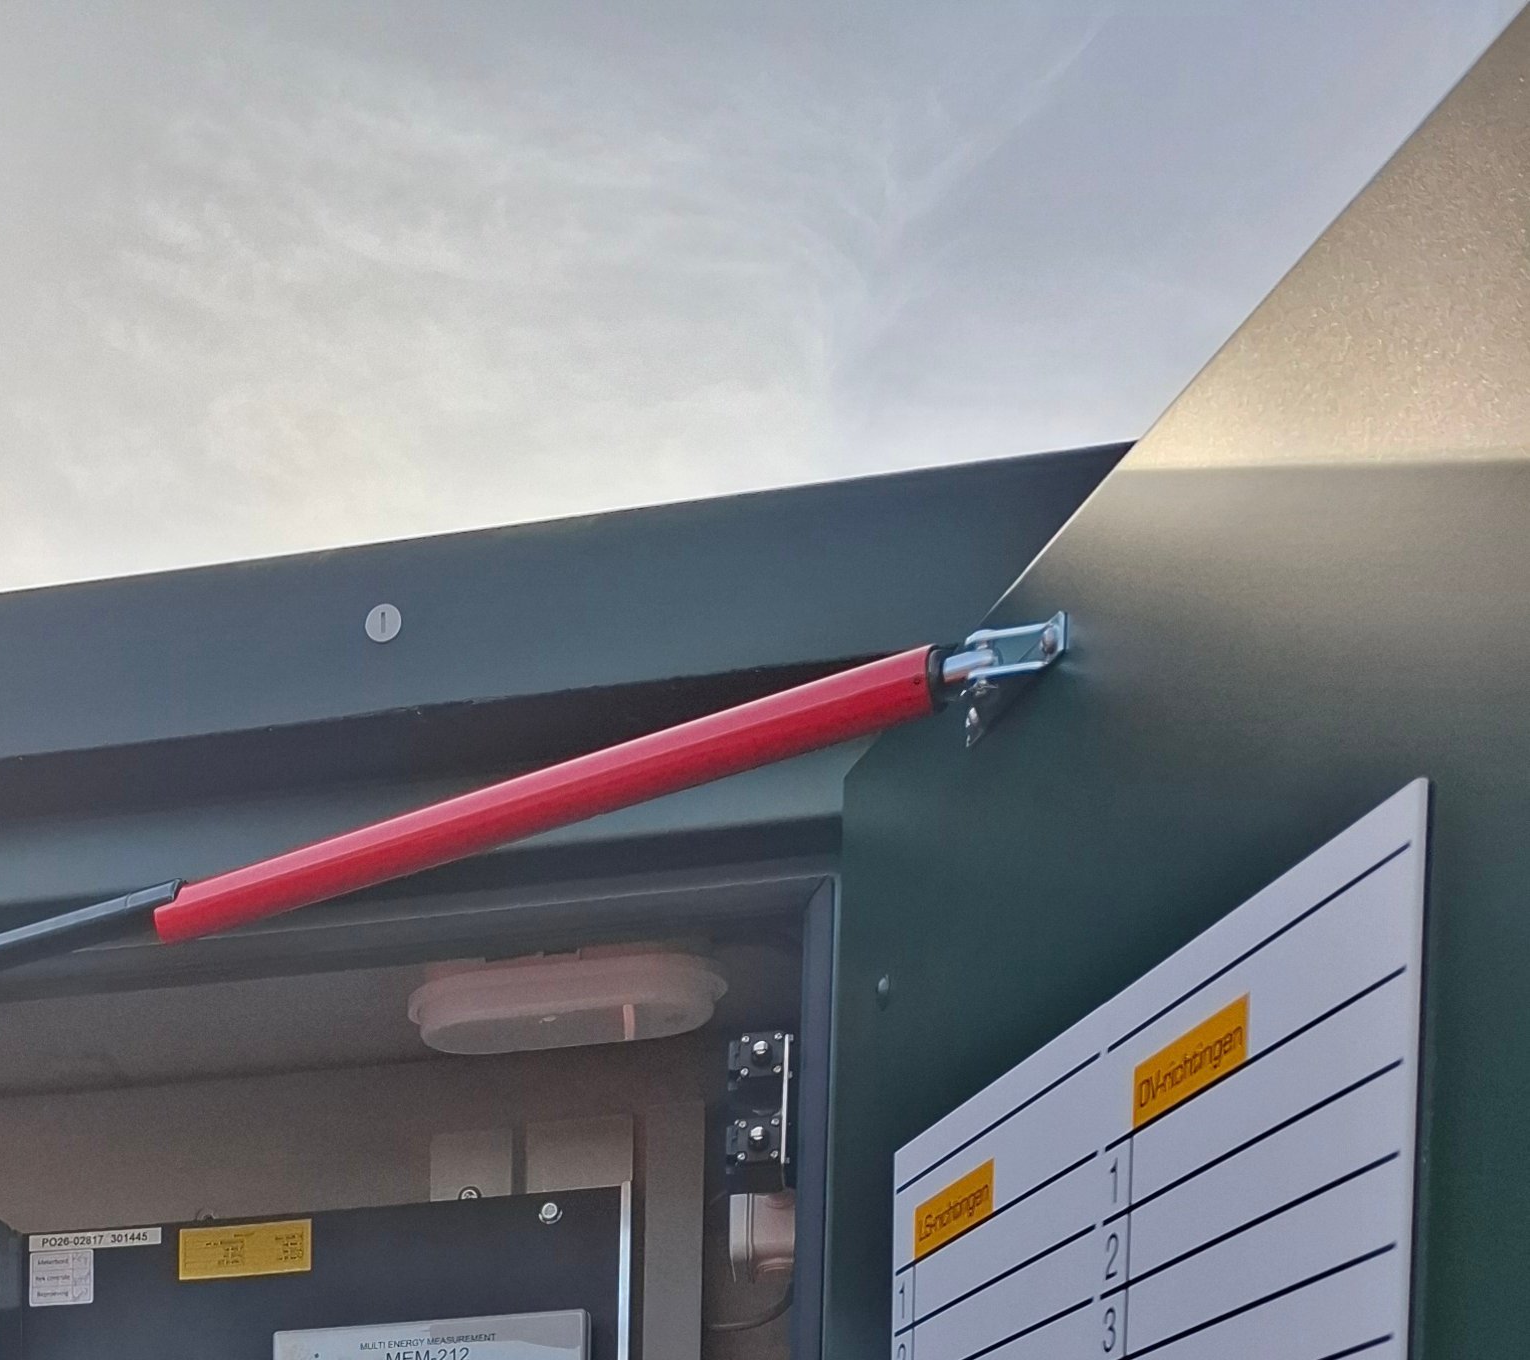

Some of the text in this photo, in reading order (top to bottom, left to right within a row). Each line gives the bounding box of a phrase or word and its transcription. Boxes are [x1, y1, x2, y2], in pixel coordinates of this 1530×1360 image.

[1110, 1157, 1118, 1203] 1
[42, 1231, 148, 1248] PO26-02817 301445
[1105, 1233, 1119, 1280] 2
[899, 1281, 905, 1319] 1
[360, 1333, 497, 1351] MULTI ENERGY MEASUREMENT
[1102, 1307, 1116, 1352] 3
